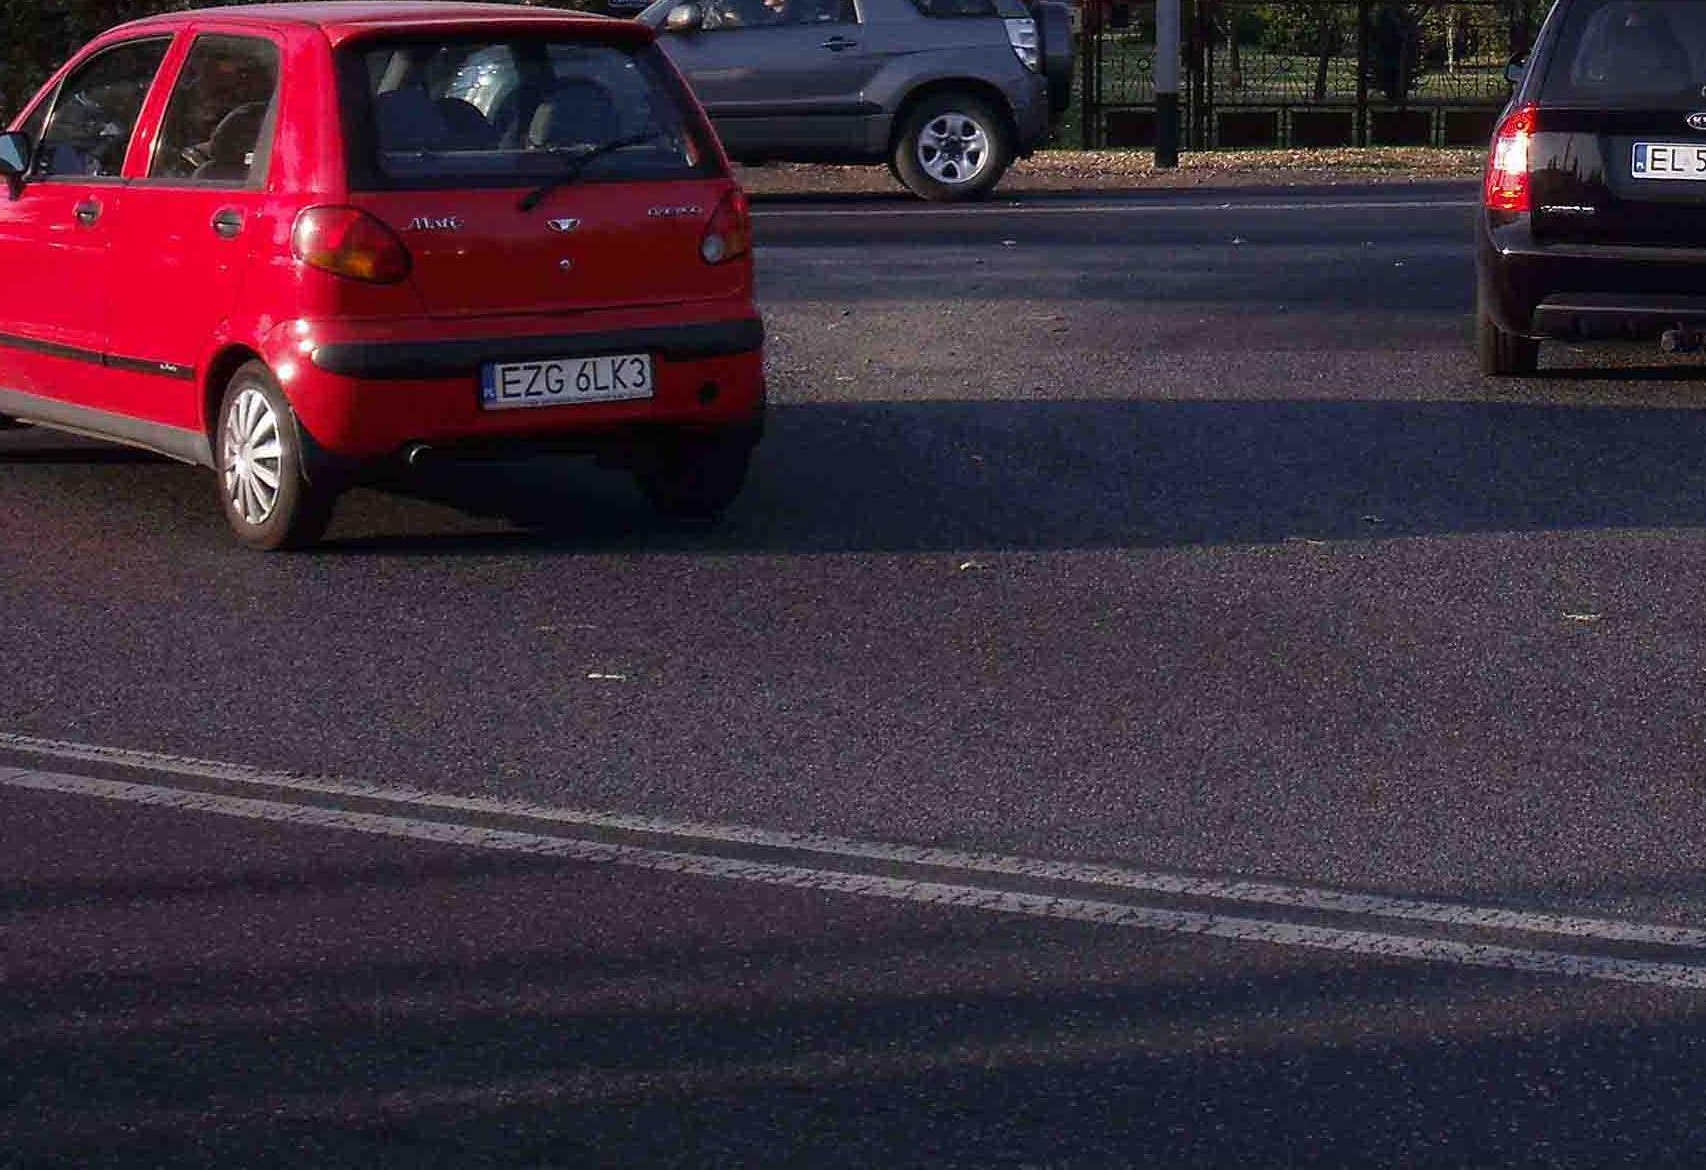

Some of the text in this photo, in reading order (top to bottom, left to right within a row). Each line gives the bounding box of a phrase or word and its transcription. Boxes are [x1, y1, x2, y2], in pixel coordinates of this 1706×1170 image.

[1650, 148, 1685, 172] EL
[501, 358, 646, 398] EZG 6LK3
